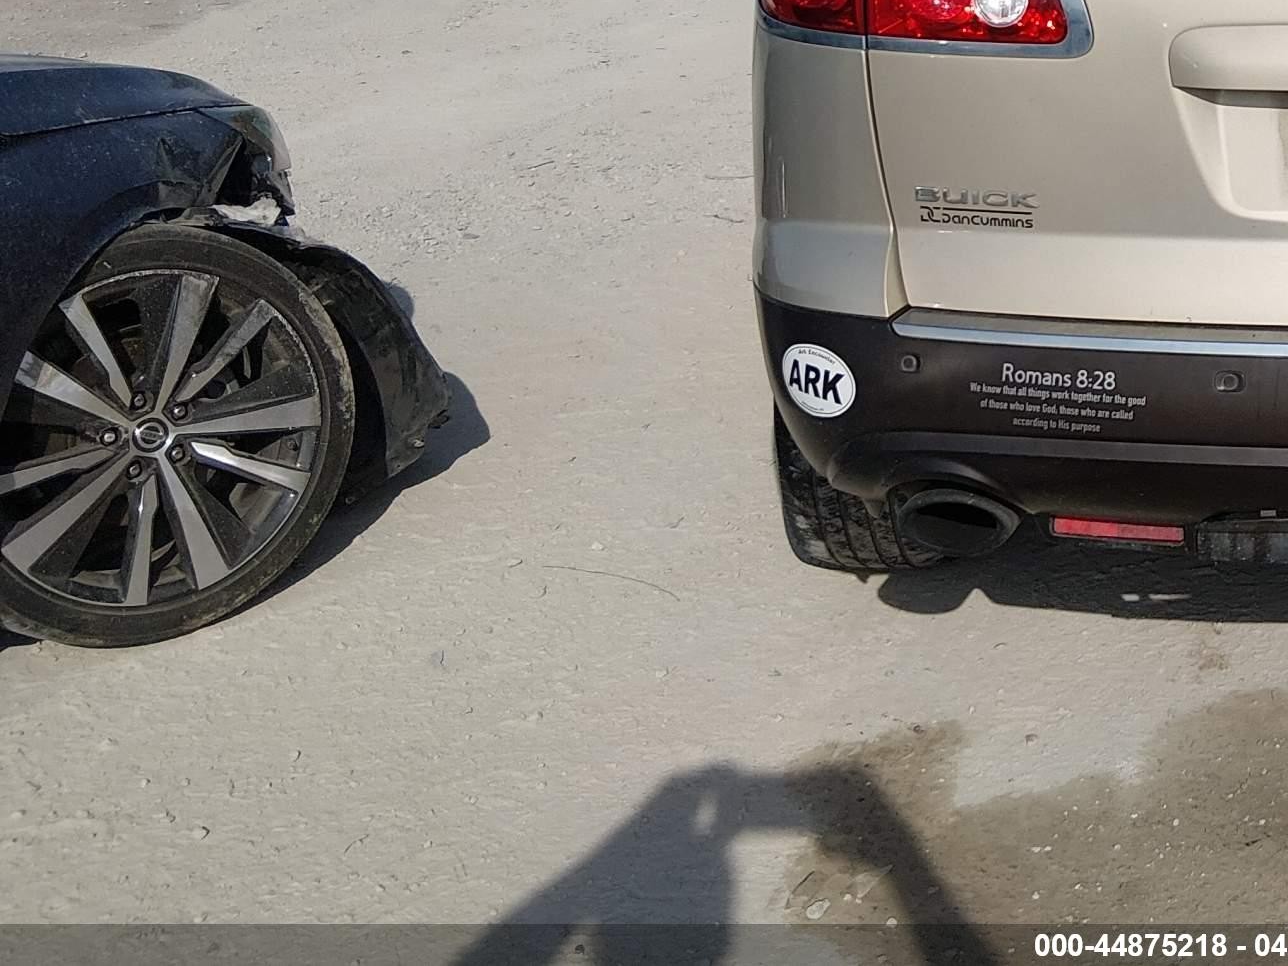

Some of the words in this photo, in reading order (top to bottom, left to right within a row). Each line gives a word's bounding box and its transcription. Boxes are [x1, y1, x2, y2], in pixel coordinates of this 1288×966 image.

[914, 186, 1040, 209] BUICK
[789, 359, 845, 405] ARK
[1002, 362, 1072, 387] Romans
[1076, 370, 1116, 390] 8:28
[970, 382, 981, 392] We
[982, 383, 1001, 394] know
[1003, 385, 1017, 395] that
[1017, 387, 1027, 396] all
[1028, 387, 1050, 400] things
[1051, 390, 1070, 400] work
[1071, 391, 1101, 403] together
[1102, 393, 1113, 403] for
[1114, 394, 1126, 404] the
[1127, 396, 1146, 407] good
[980, 398, 988, 407] of
[989, 399, 1008, 410] those
[1009, 401, 1024, 411] who
[1026, 402, 1040, 412] love
[1059, 404, 1079, 415] those
[1081, 406, 1096, 417] who
[1097, 410, 1109, 418] are
[1111, 409, 1134, 420] called
[1012, 417, 1048, 430] according
[1049, 419, 1057, 428] to
[1058, 419, 1070, 429] His
[1071, 422, 1100, 434] purpose
